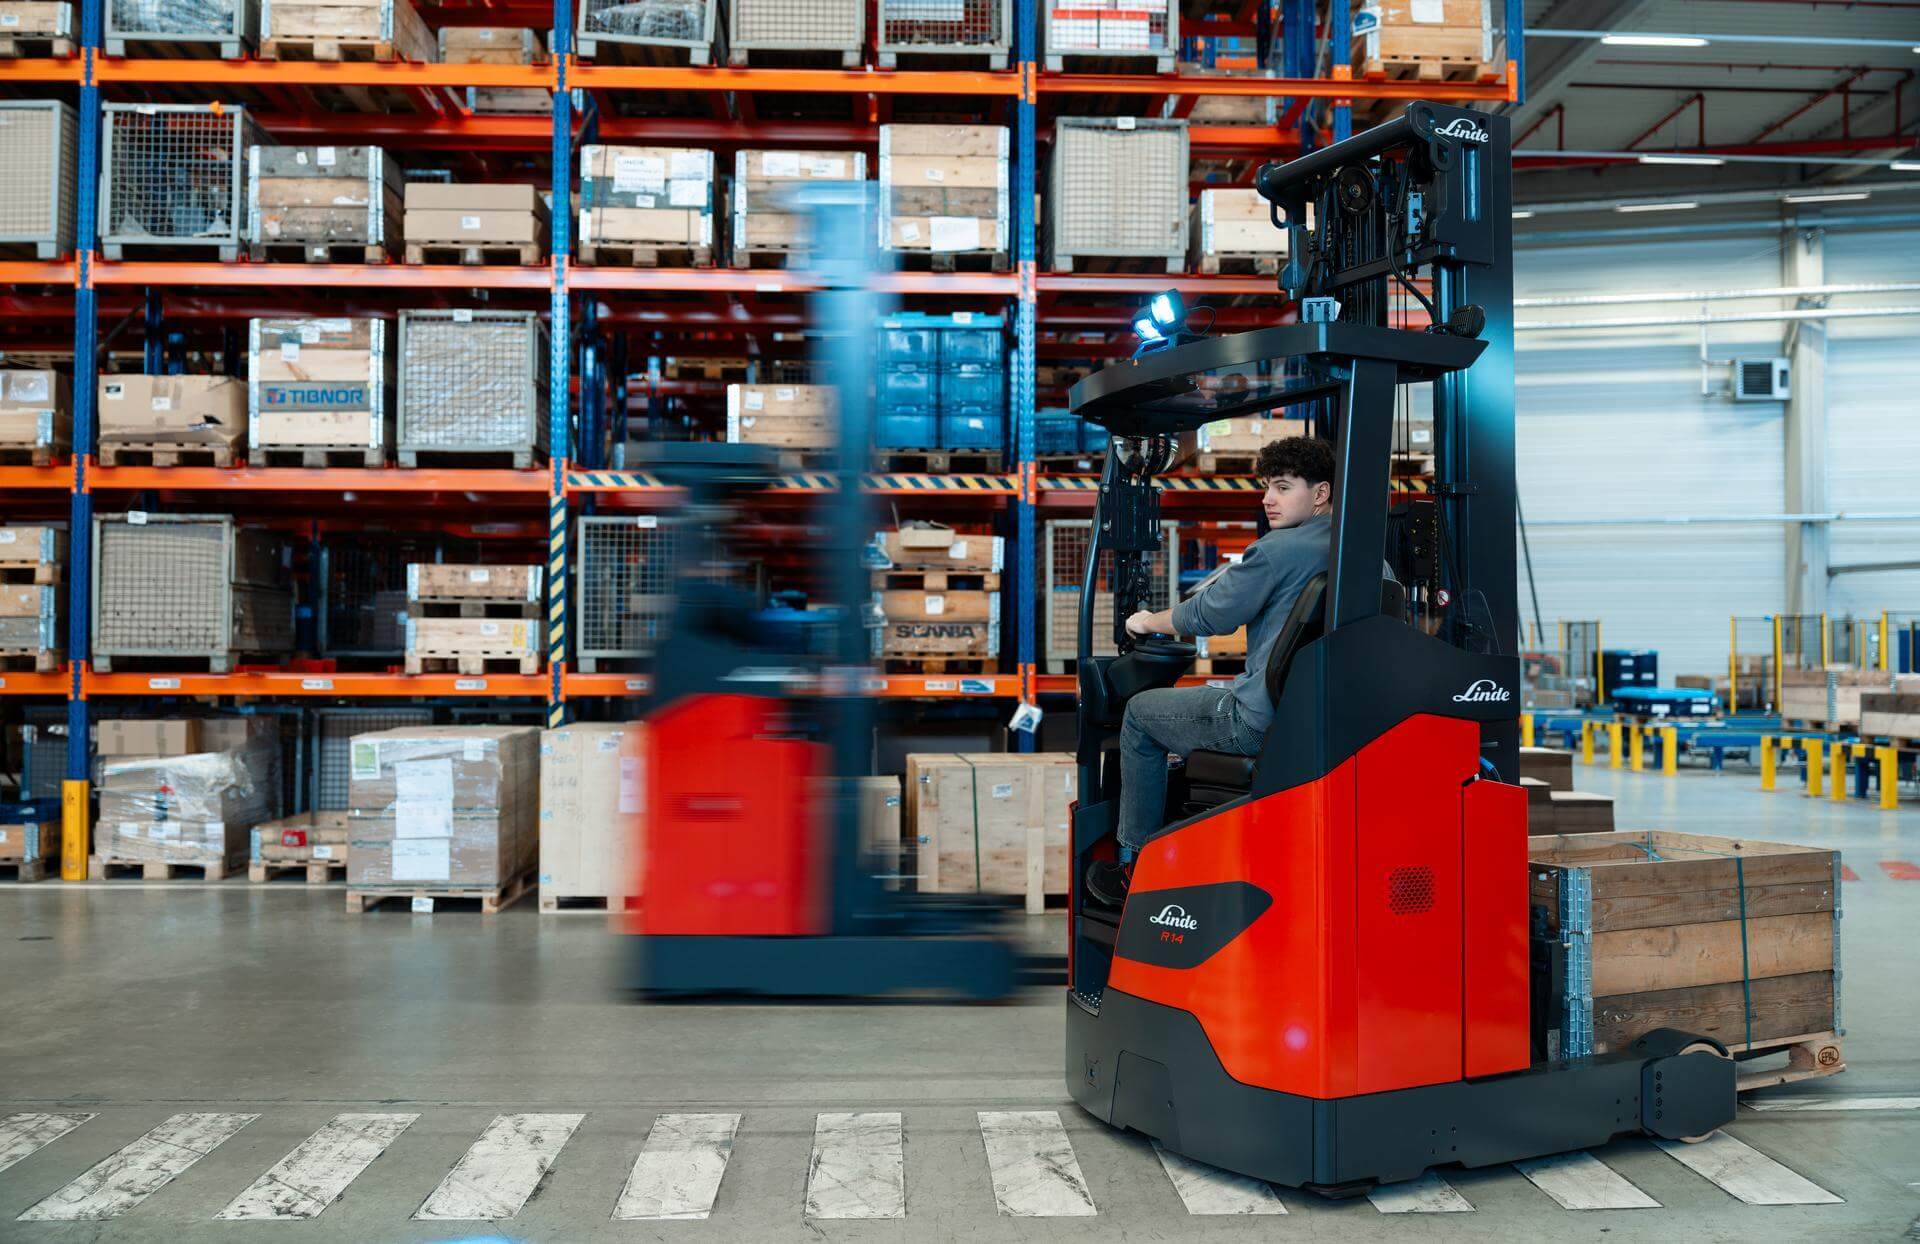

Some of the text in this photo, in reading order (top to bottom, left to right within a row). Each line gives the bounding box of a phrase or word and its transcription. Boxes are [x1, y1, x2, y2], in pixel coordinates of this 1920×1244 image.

[1435, 118, 1489, 142] Linde
[289, 389, 363, 404] TIBNOR
[896, 625, 976, 638] SCANIA
[1452, 679, 1510, 702] Linde
[1149, 904, 1198, 930] Linde
[1160, 931, 1184, 944] R14
